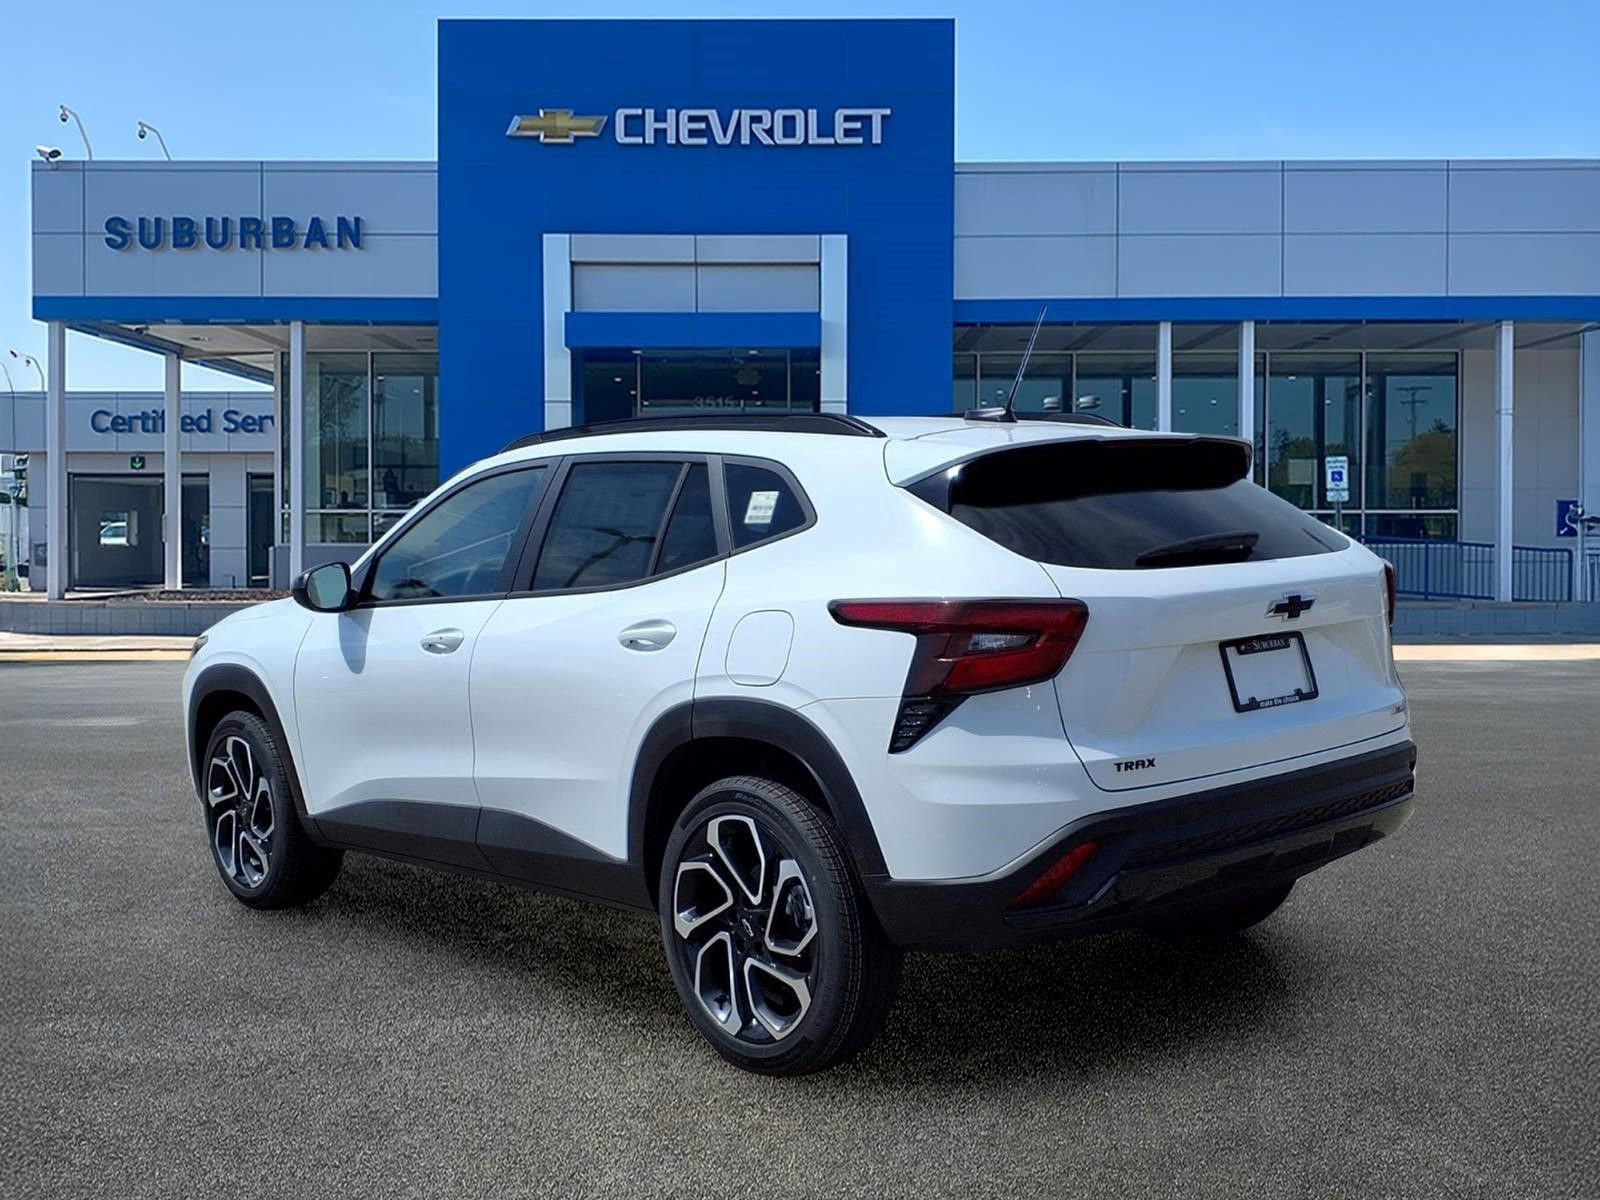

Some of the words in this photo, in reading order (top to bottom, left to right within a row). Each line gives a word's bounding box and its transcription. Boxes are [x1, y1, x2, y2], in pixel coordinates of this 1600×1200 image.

[614, 107, 892, 146] CHEVROLET
[104, 215, 365, 251] SUBURBAN
[90, 409, 213, 434] Certifed
[1113, 757, 1156, 773] TRAX
